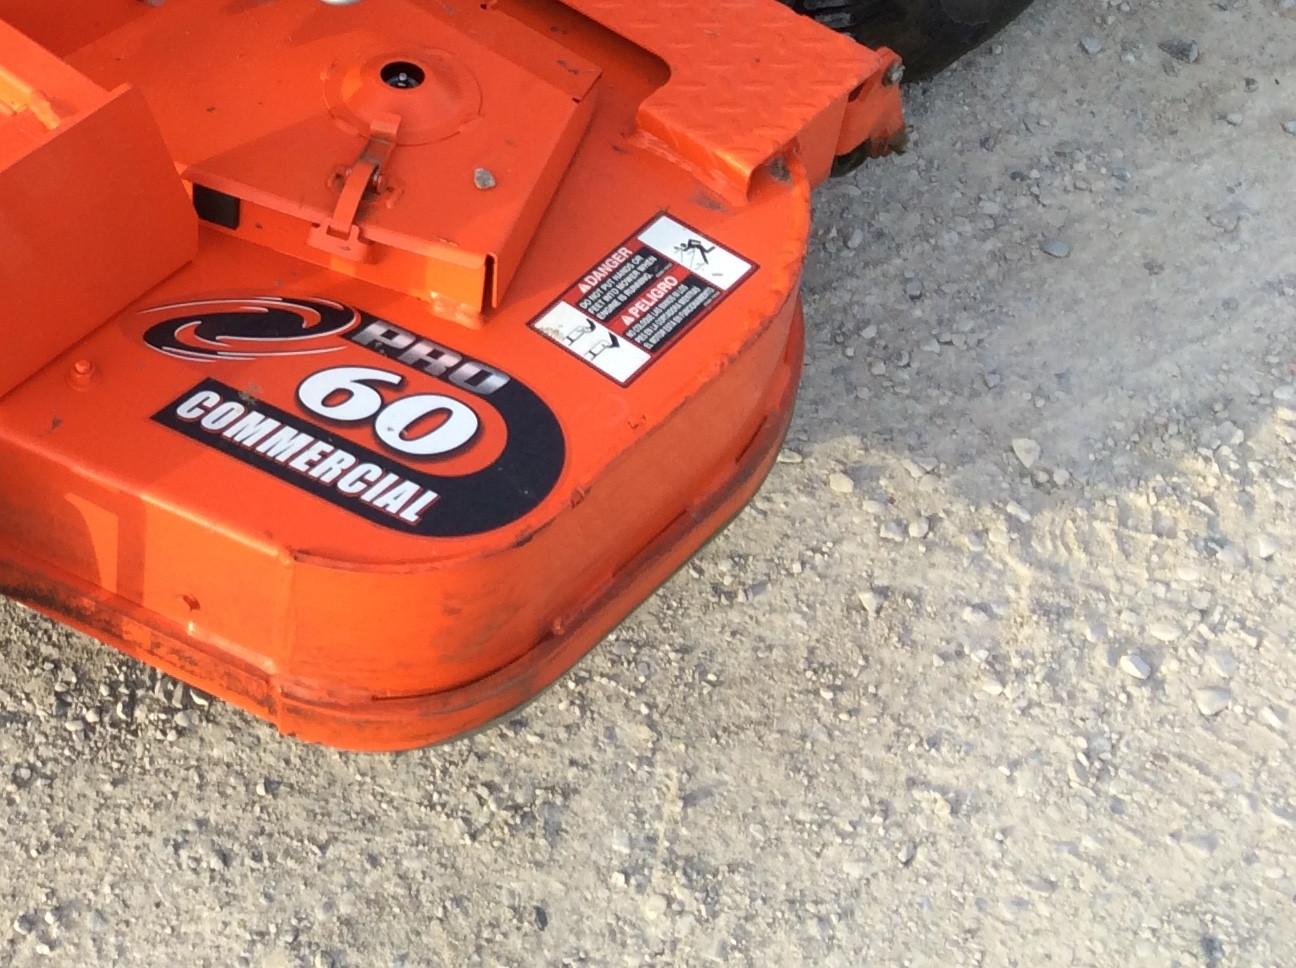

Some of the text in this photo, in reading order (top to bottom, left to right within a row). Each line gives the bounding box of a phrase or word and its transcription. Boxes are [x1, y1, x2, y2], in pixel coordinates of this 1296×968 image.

[582, 246, 633, 286] DANGER
[600, 278, 615, 291] PUT
[631, 254, 644, 265] OR
[587, 298, 605, 314] FEET
[615, 269, 640, 290] MOWER
[626, 274, 680, 318] PELIGRO
[351, 320, 511, 395] PRO
[297, 365, 479, 455] 60
[175, 390, 441, 525] COMMERCIAL
